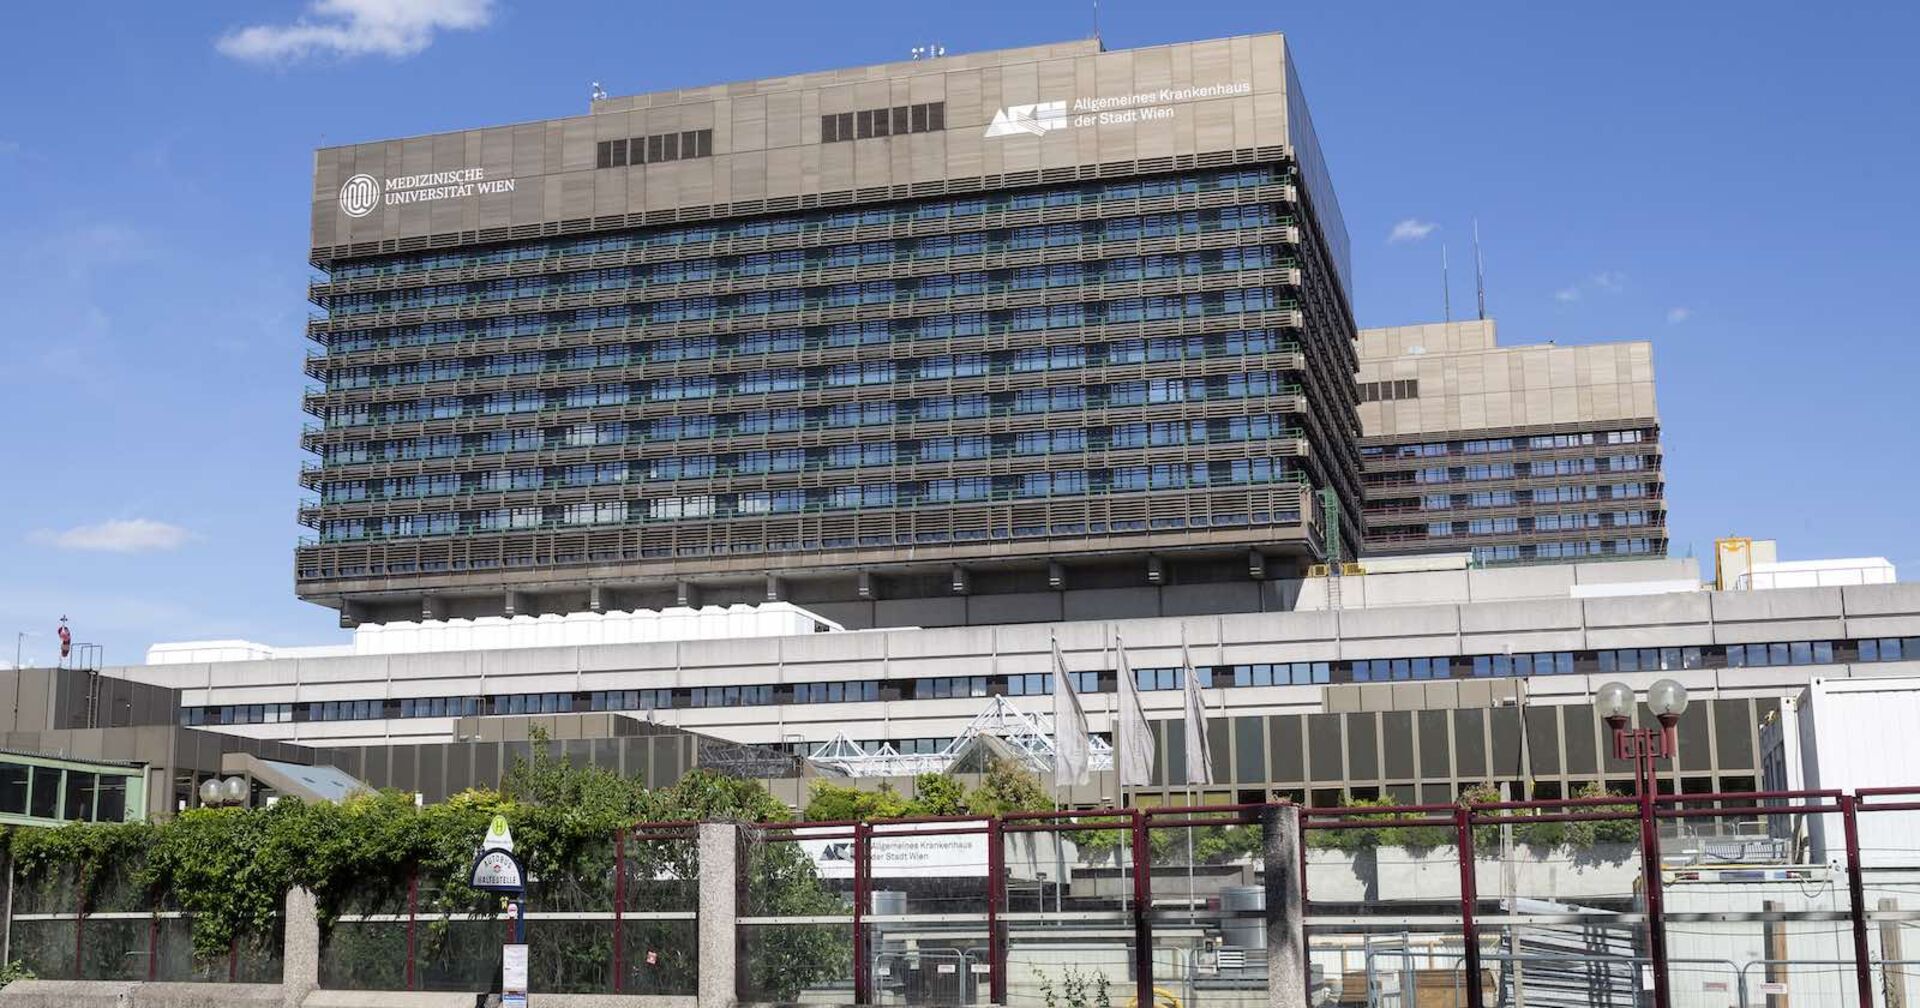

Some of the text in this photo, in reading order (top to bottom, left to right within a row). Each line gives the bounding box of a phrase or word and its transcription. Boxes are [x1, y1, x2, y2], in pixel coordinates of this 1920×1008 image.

[1074, 81, 1251, 112] Allgemeines Krankenhaus
[1074, 106, 1174, 127] der Stadt Wien
[385, 168, 484, 191] MEDIZINISCHE
[385, 179, 516, 205] UNIVERSITÄT WIEN
[920, 840, 972, 850] Krankenhaus
[885, 852, 908, 861] Stadt
[909, 852, 929, 860] Wien
